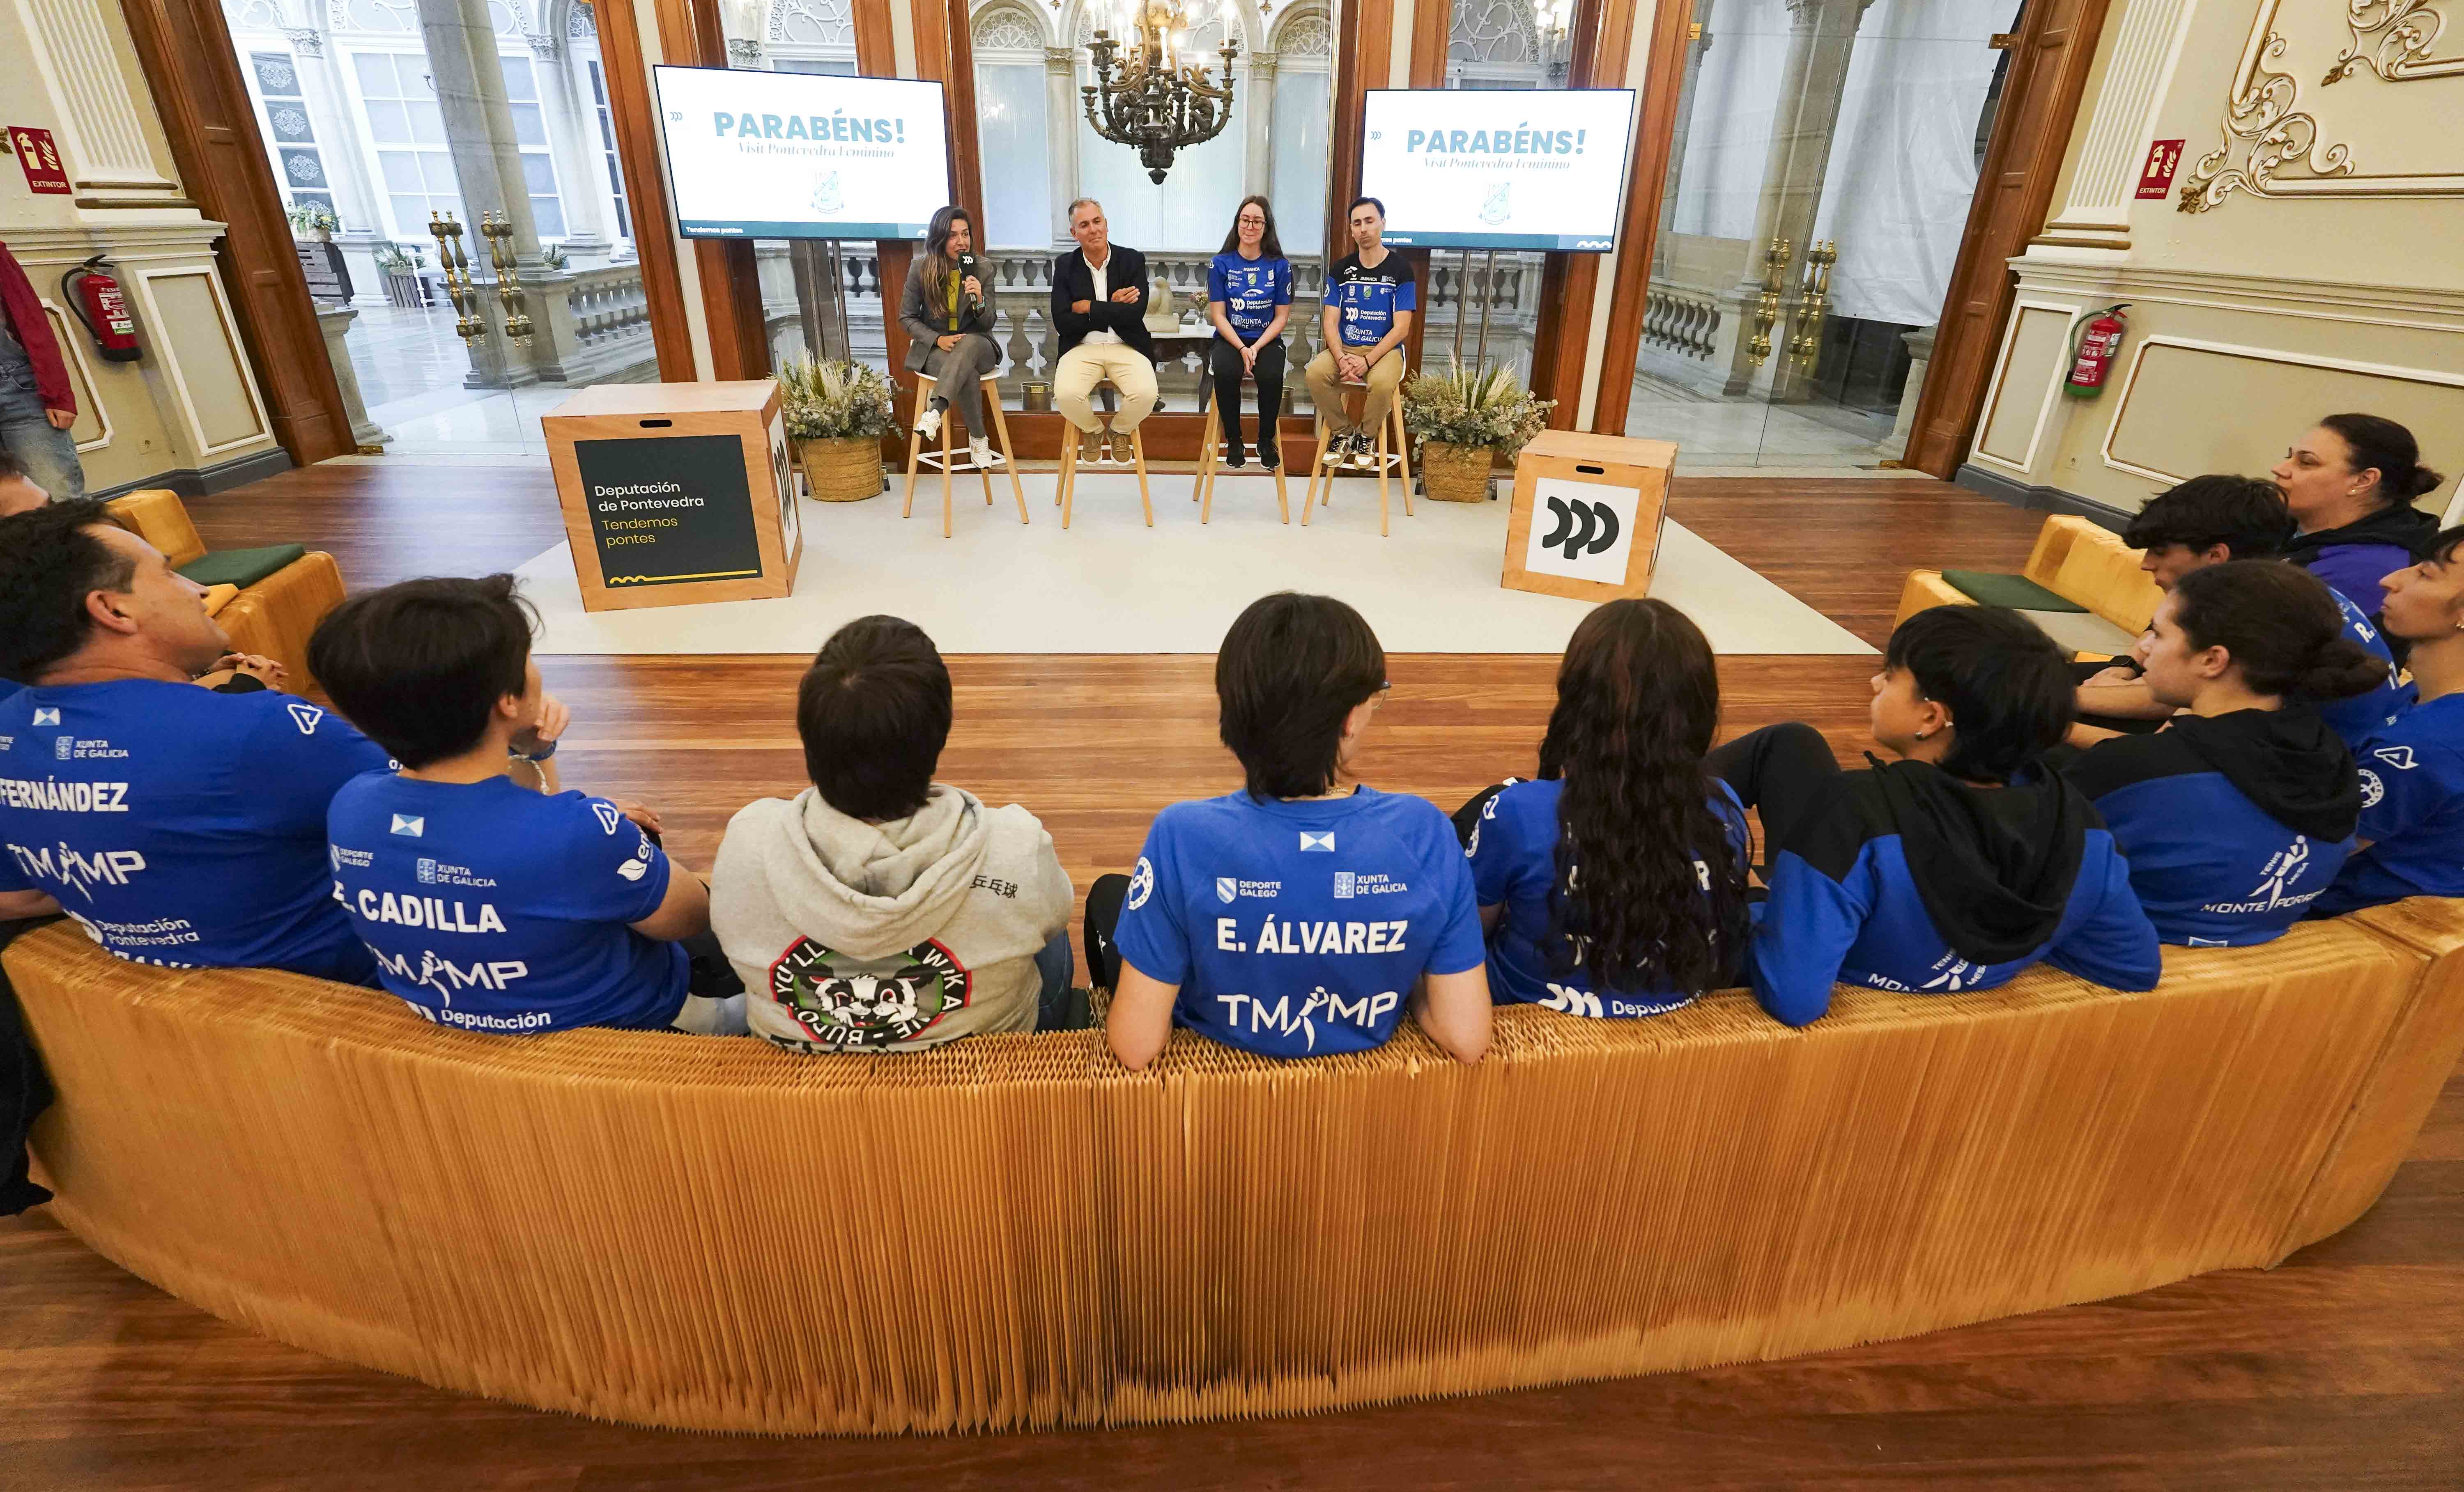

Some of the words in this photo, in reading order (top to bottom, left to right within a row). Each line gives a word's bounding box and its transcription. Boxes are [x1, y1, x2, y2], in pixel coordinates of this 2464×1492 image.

[714, 108, 905, 144] PARABÉNS!
[1407, 121, 1586, 155] PARABÉNS!
[739, 142, 763, 155] Visit
[768, 143, 836, 157] Pontevedra
[1423, 157, 1447, 168] Visit
[1450, 157, 1513, 169] Pontevedra
[595, 481, 680, 499] Deputación
[598, 501, 617, 512] de
[620, 496, 704, 511] Pontevedra
[602, 518, 678, 530] Tendemos
[606, 534, 656, 549] pontes
[76, 740, 109, 748] XUNTA
[73, 749, 86, 758] DE
[89, 749, 129, 758] GALICIA
[437, 864, 471, 876] XUNTA
[437, 874, 451, 883] DE
[453, 875, 497, 887] GALICIA
[1239, 880, 1282, 890] DEPORTE
[1356, 874, 1389, 884] XUNTA
[969, 875, 1018, 899] 乒乓球
[1239, 888, 1278, 898] GALEGO
[1356, 884, 1370, 895] DE
[1372, 883, 1408, 894] GALICIA
[358, 888, 507, 933] CADILLA
[2200, 901, 2268, 914] MONTE
[95, 918, 191, 933] Deputación
[106, 932, 200, 946] Pontevedra
[1217, 918, 1246, 952] E.
[1256, 914, 1409, 954] ÁLVAREZ
[441, 1010, 552, 1029] Deputación
